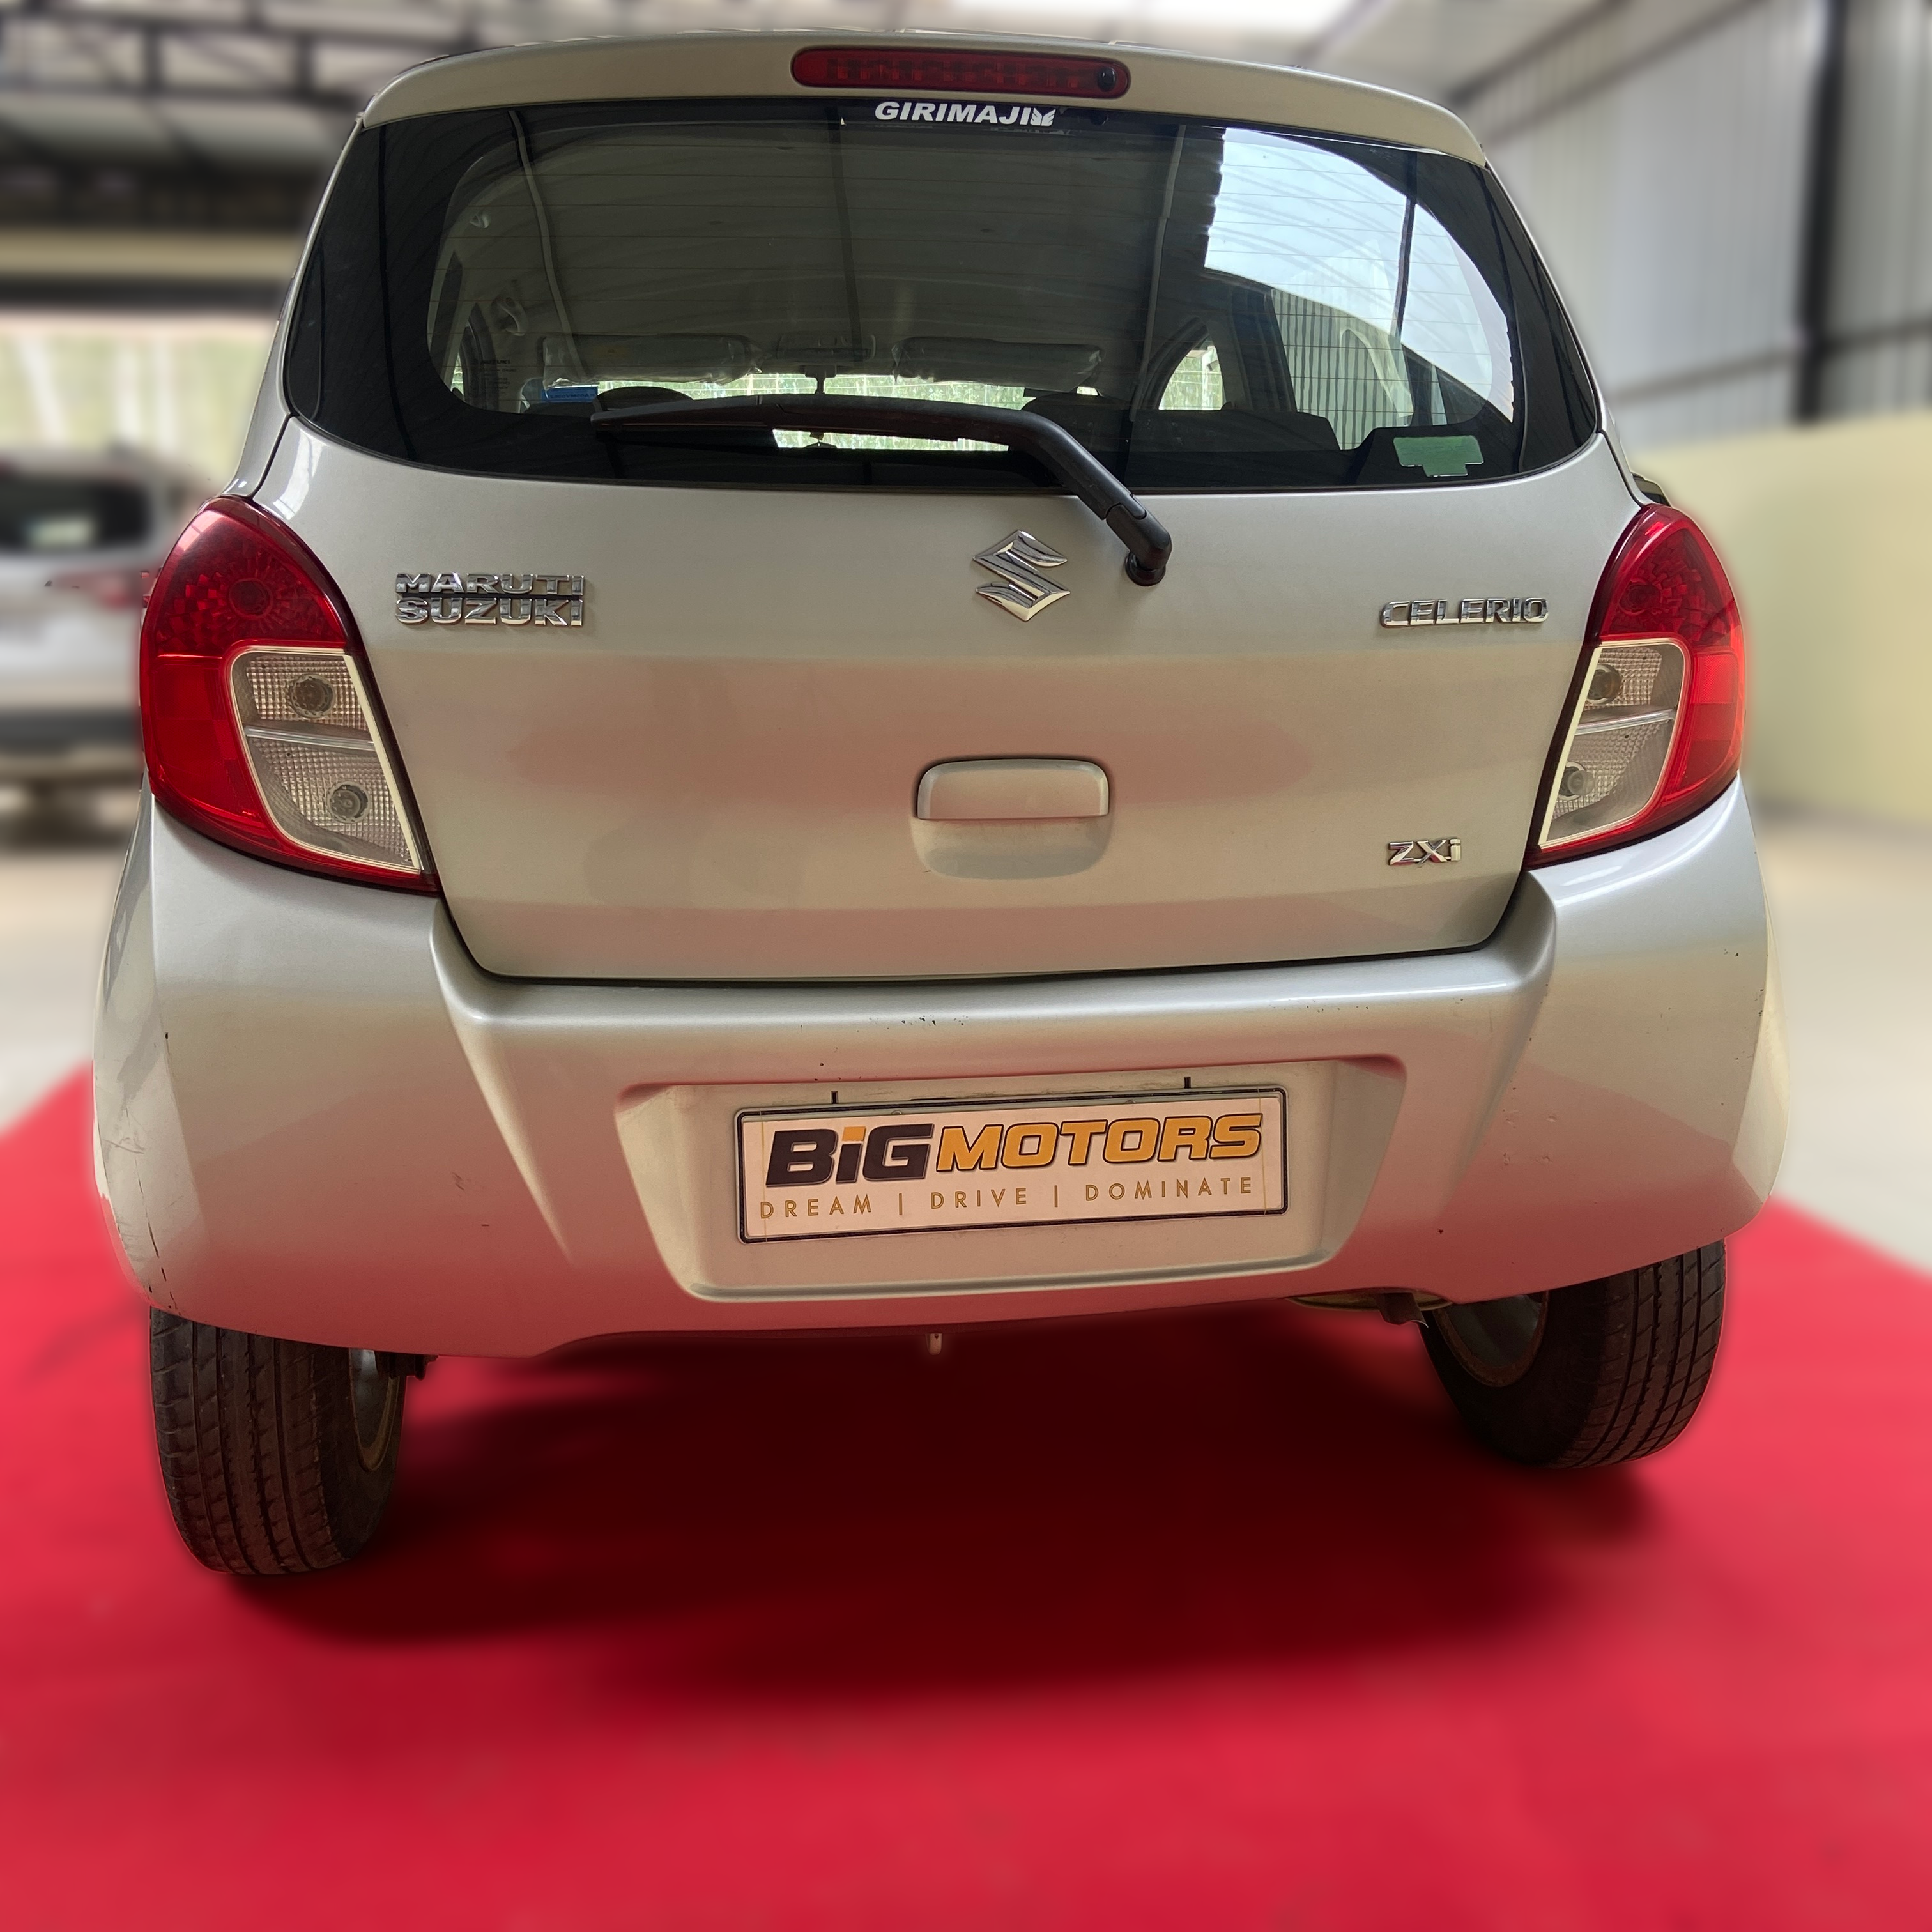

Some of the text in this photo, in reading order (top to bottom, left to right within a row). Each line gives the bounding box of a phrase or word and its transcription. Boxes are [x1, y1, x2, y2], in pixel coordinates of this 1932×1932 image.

[875, 101, 1032, 125] GIRIMAJI
[395, 572, 585, 595] MARUTI
[395, 597, 583, 626] SUZUKI
[1381, 597, 1549, 627] CELERIO
[935, 1113, 1263, 1173] MOTORS
[760, 1177, 1252, 1219] DREAM DRIVE DOMINATE
